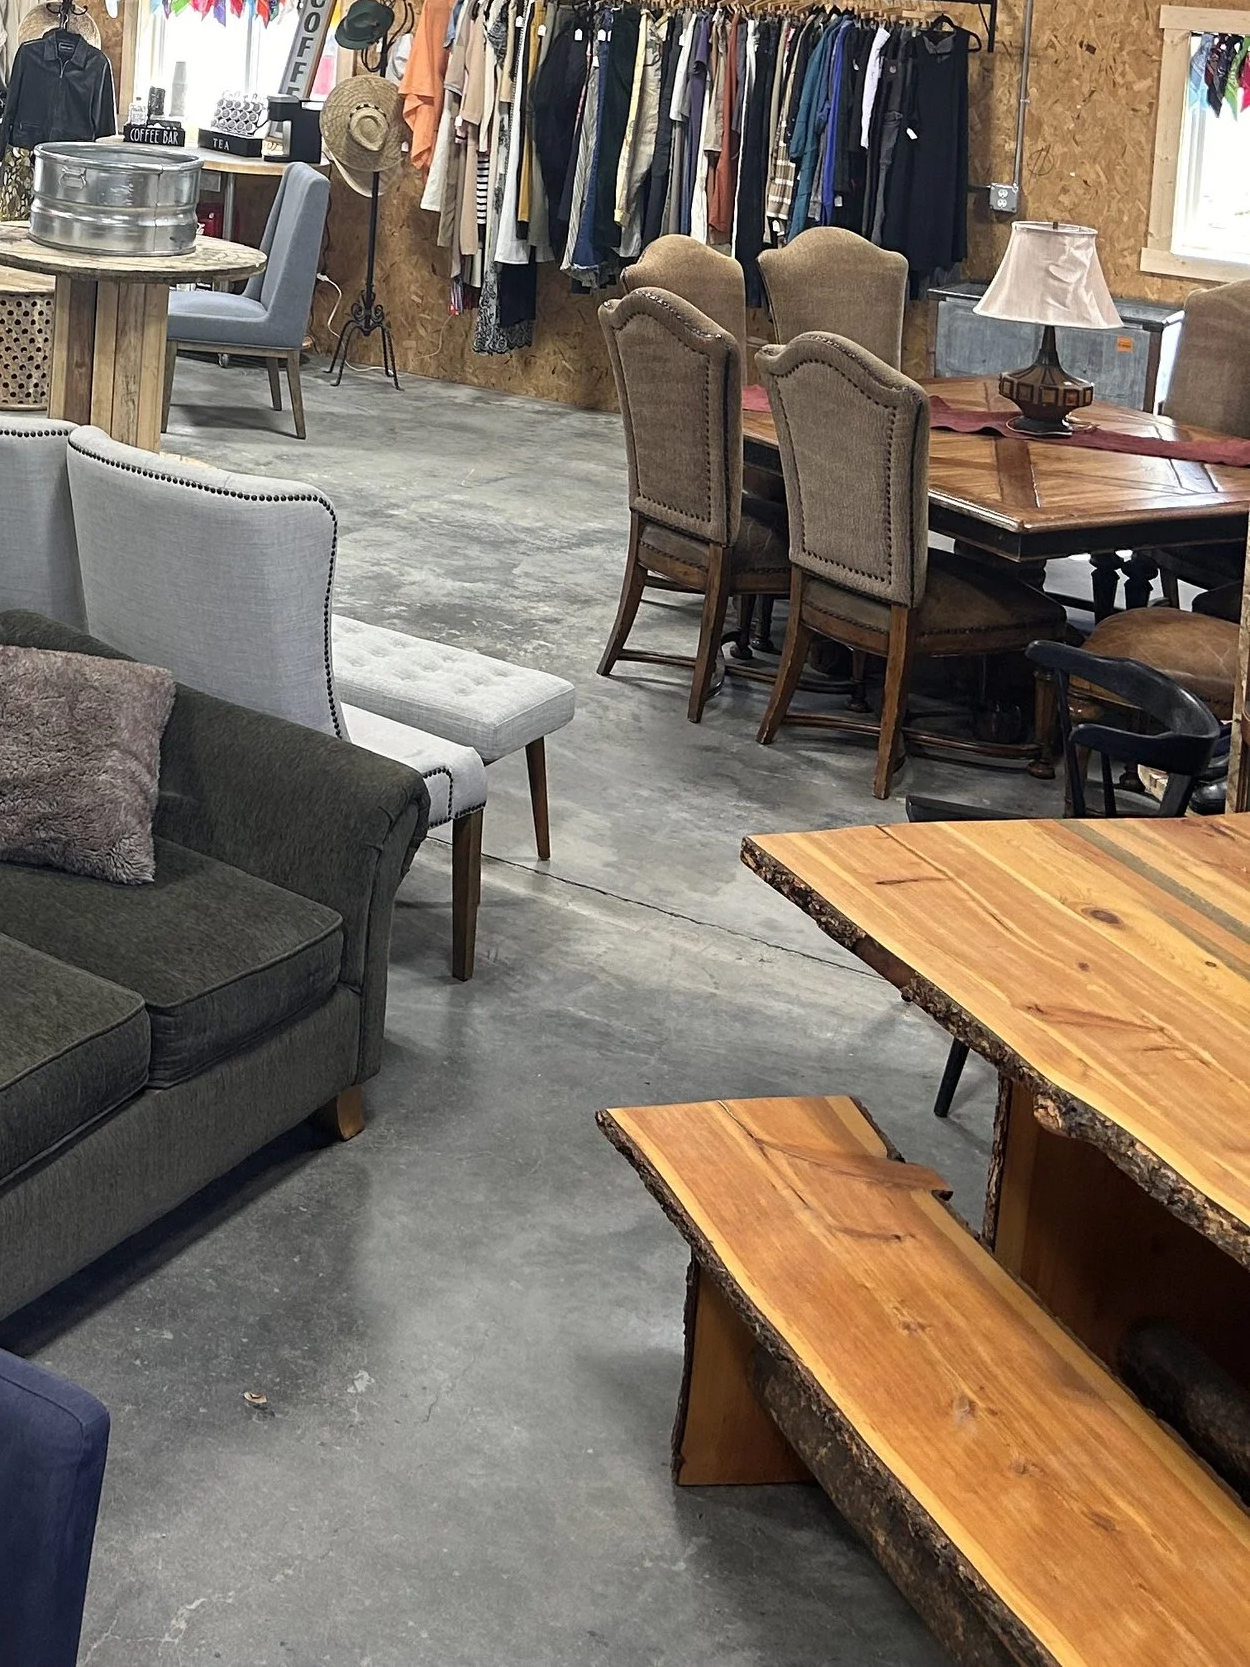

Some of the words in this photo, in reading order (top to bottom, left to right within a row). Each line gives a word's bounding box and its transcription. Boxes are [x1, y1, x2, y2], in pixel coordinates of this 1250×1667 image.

[130, 128, 160, 144] COFFEE
[162, 130, 179, 145] BAR
[213, 138, 230, 151] TEA
